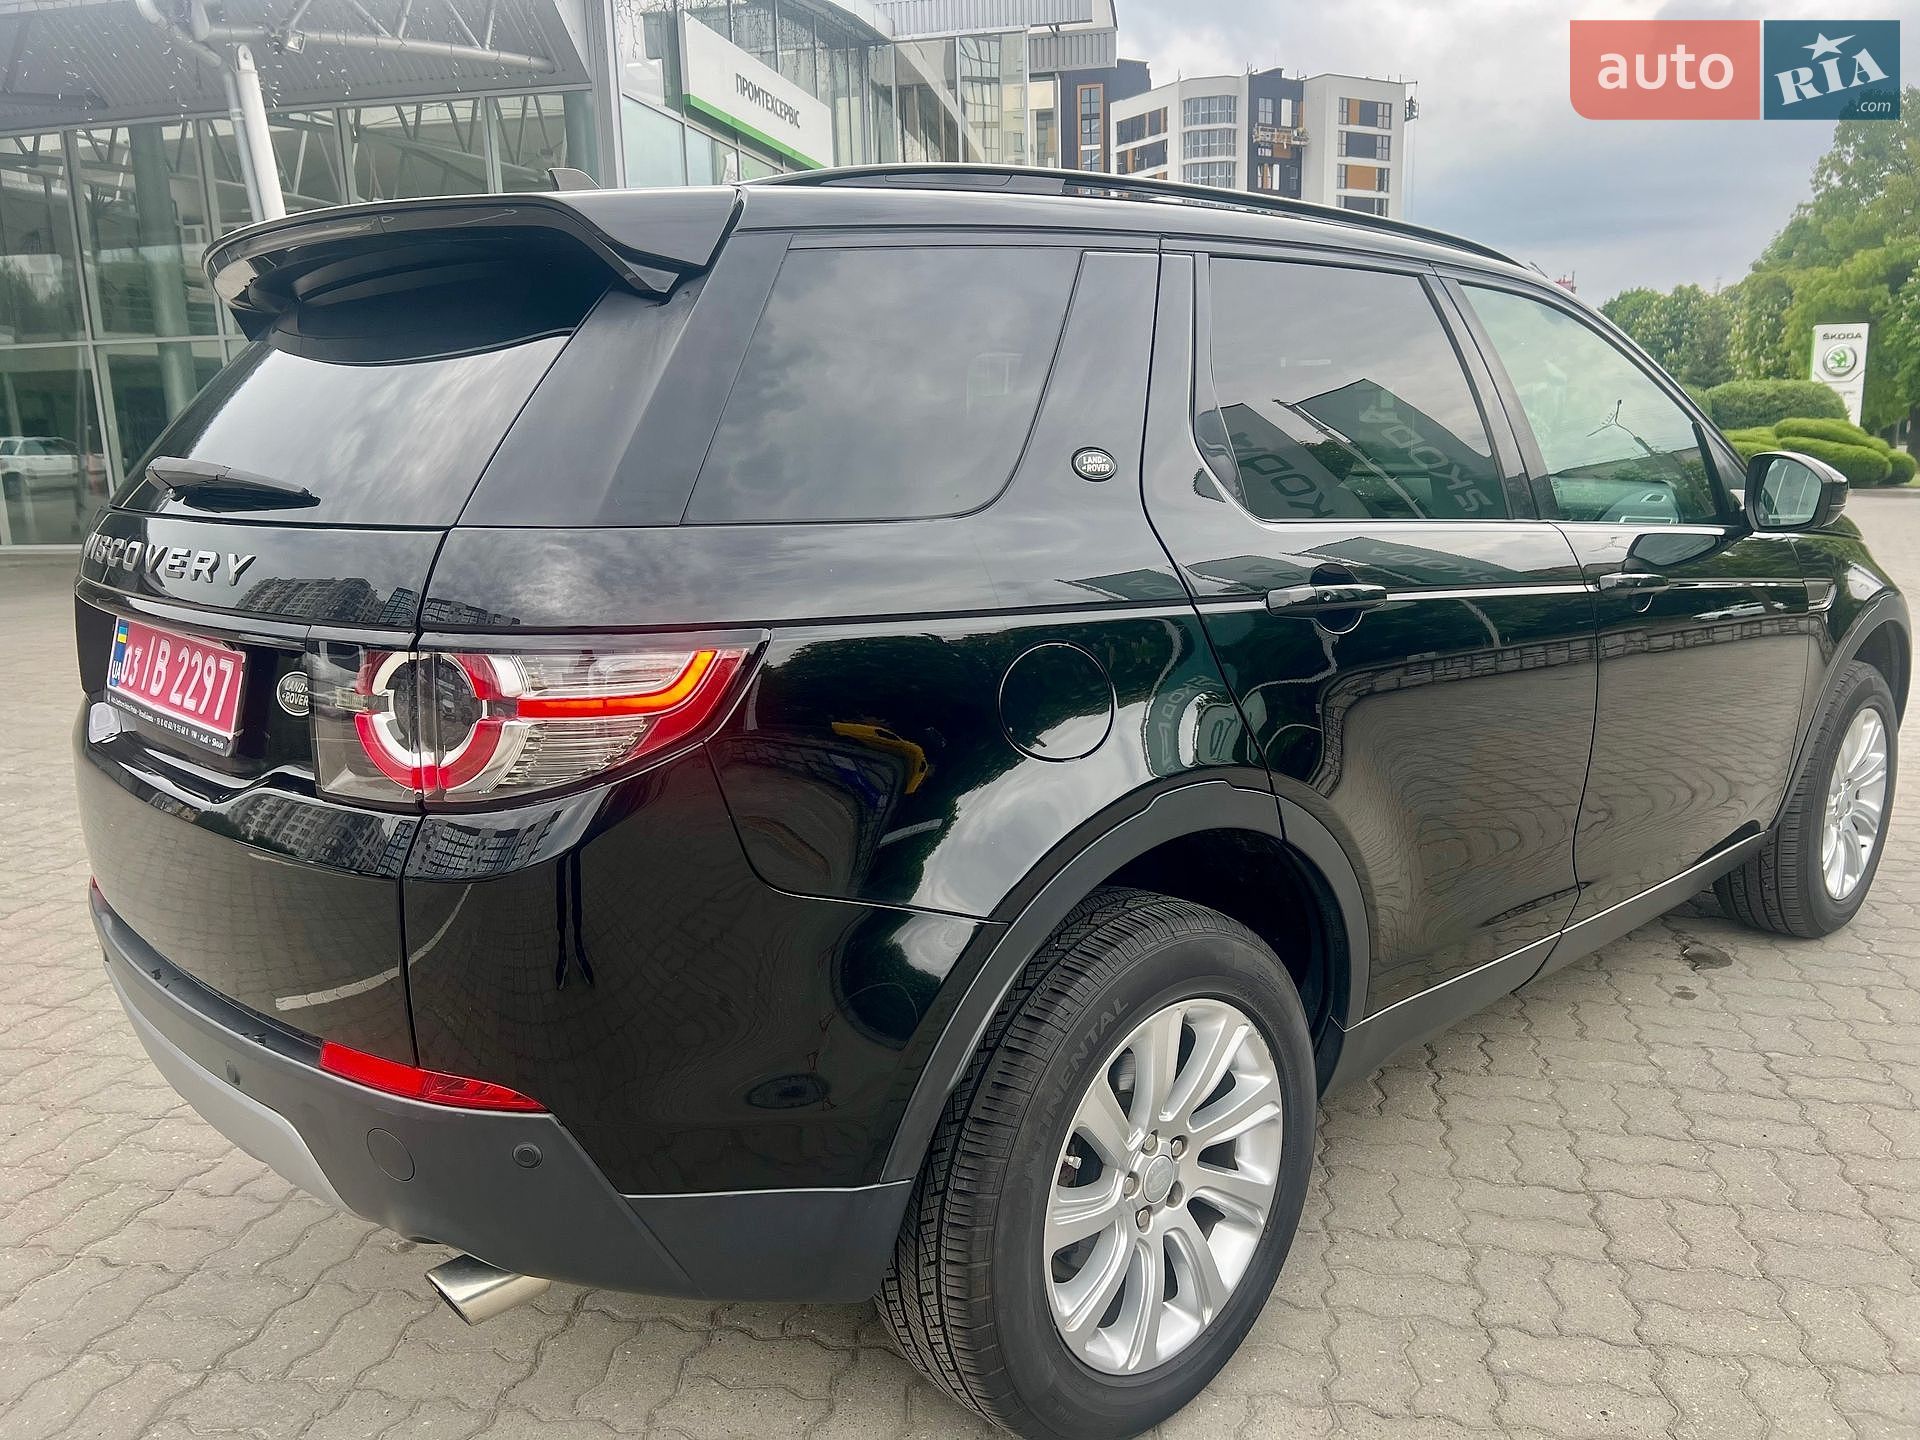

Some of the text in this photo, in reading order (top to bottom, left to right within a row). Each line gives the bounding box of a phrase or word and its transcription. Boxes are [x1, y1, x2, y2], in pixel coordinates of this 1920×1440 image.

[1083, 456, 1102, 464] LAND
[1087, 463, 1110, 472] ROVER
[111, 660, 122, 680] UA
[121, 645, 142, 687] 03
[168, 646, 235, 721] 2297
[285, 680, 305, 693] LAND
[285, 691, 309, 707] ROVER
